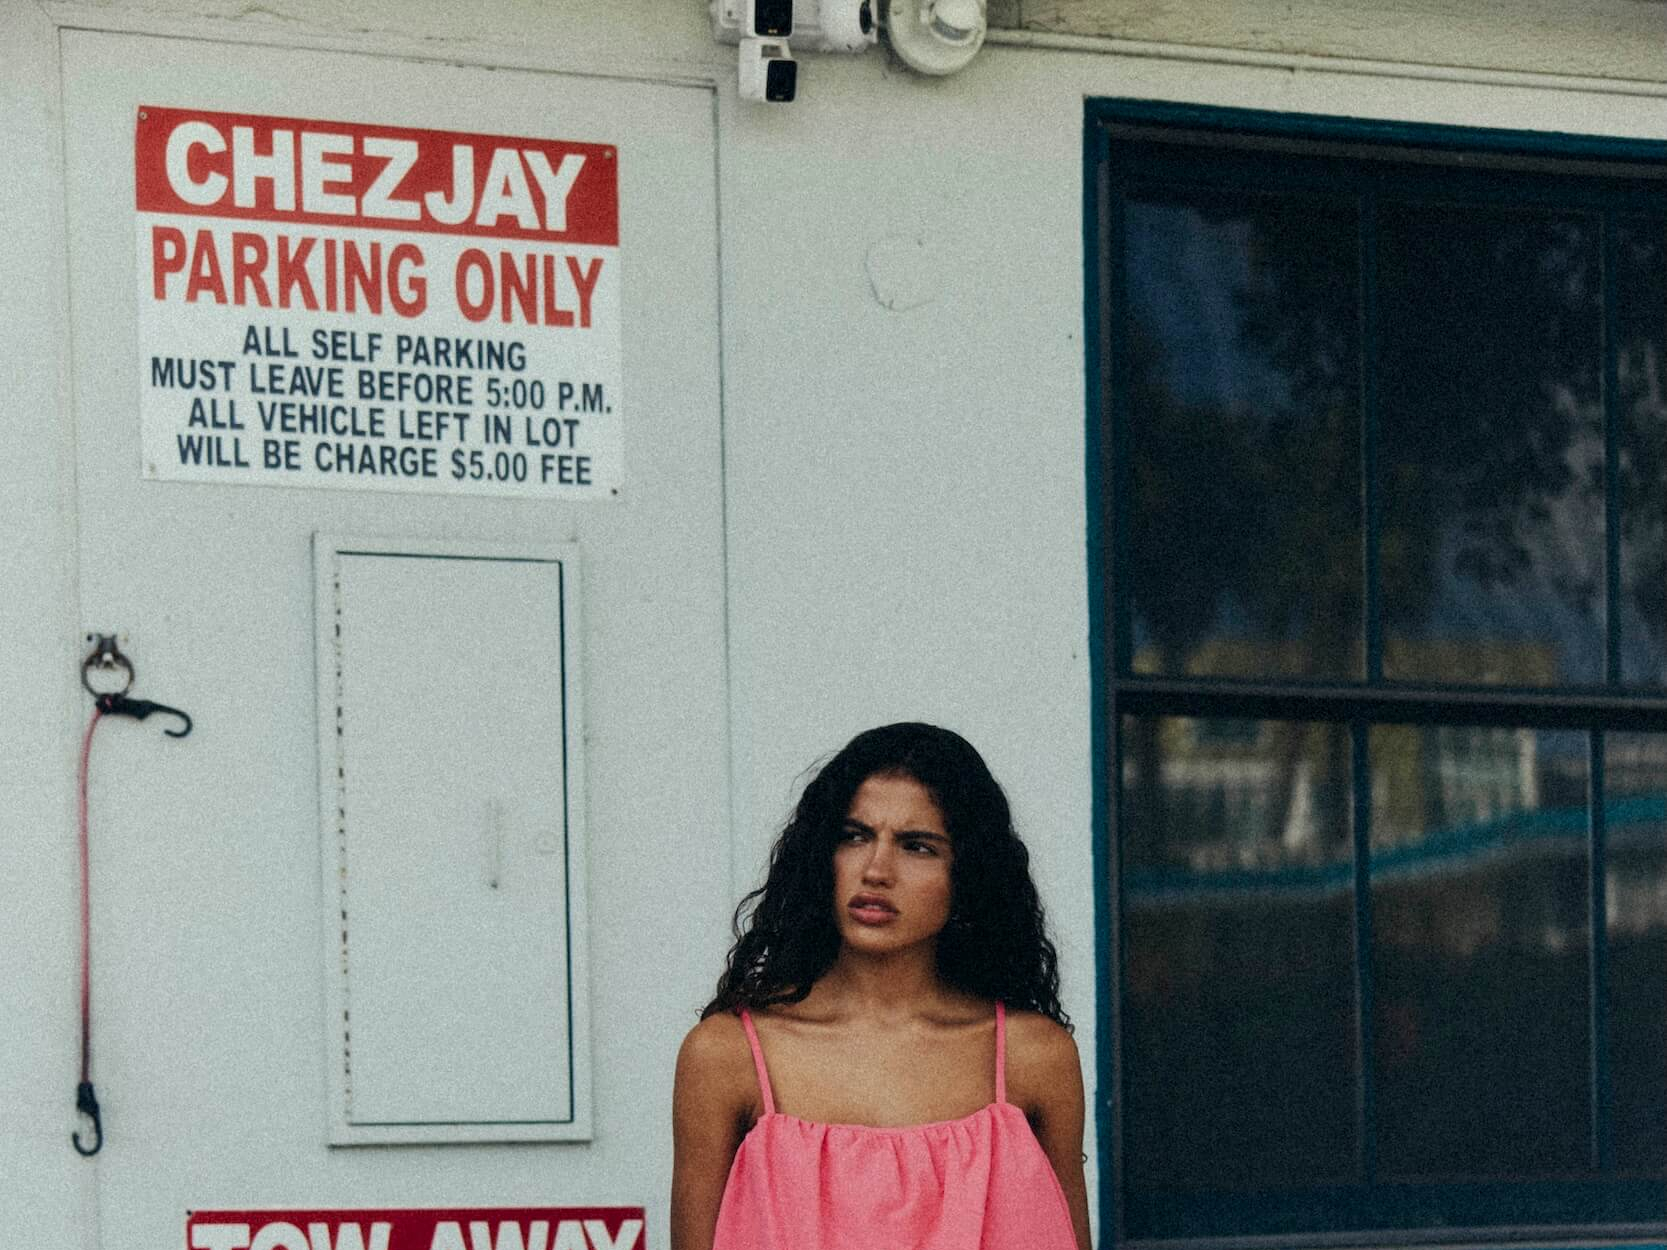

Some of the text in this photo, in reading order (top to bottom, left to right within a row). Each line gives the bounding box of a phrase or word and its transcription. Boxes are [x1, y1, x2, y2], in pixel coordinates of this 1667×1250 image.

[166, 121, 586, 232] CHEZ JAY
[152, 225, 603, 328] PARKING ONLY
[243, 325, 526, 371] ALL SELF PARKING
[152, 357, 611, 413] MUST LEAVE BEFORE 5:00 P.M.
[188, 399, 580, 448] ALL VEHICLE LEFT IN LOT
[177, 435, 592, 485] WILL BE CHARGE $5.00 FEE
